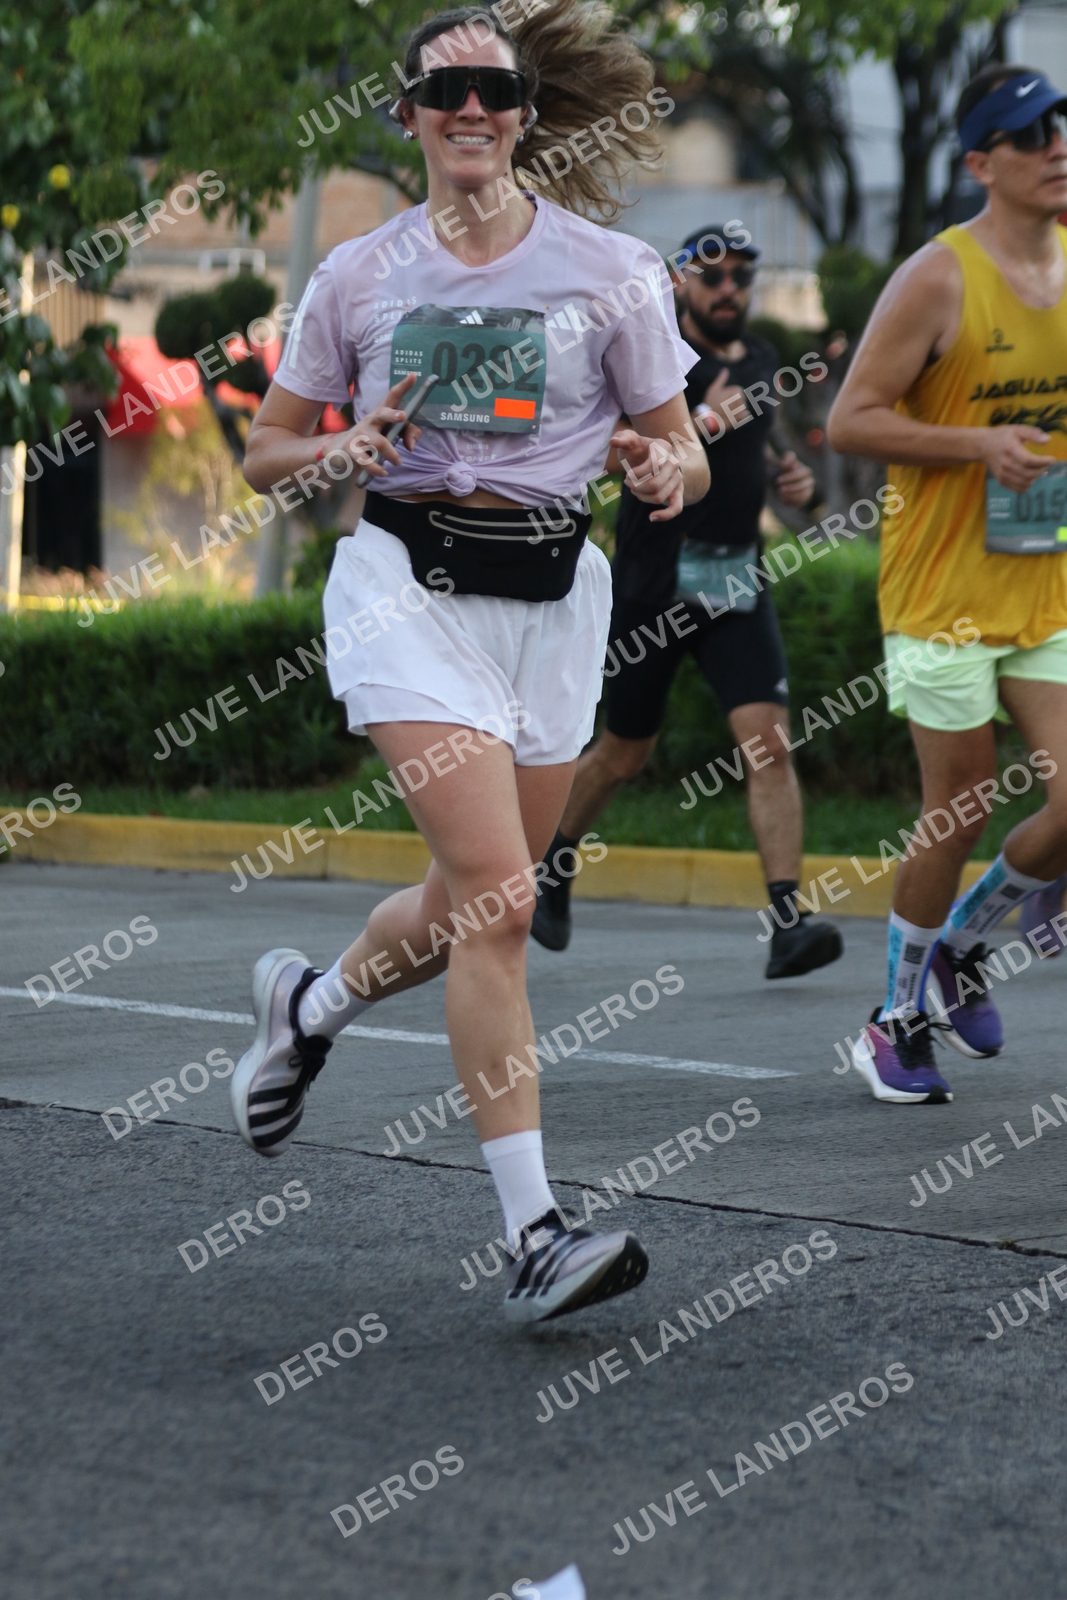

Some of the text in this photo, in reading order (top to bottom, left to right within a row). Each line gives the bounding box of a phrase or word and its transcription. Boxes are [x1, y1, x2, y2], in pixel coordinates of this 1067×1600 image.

[394, 349, 424, 357] ADIDAS
[395, 357, 423, 365] SPLITS
[440, 412, 491, 424] SAMSUNG
